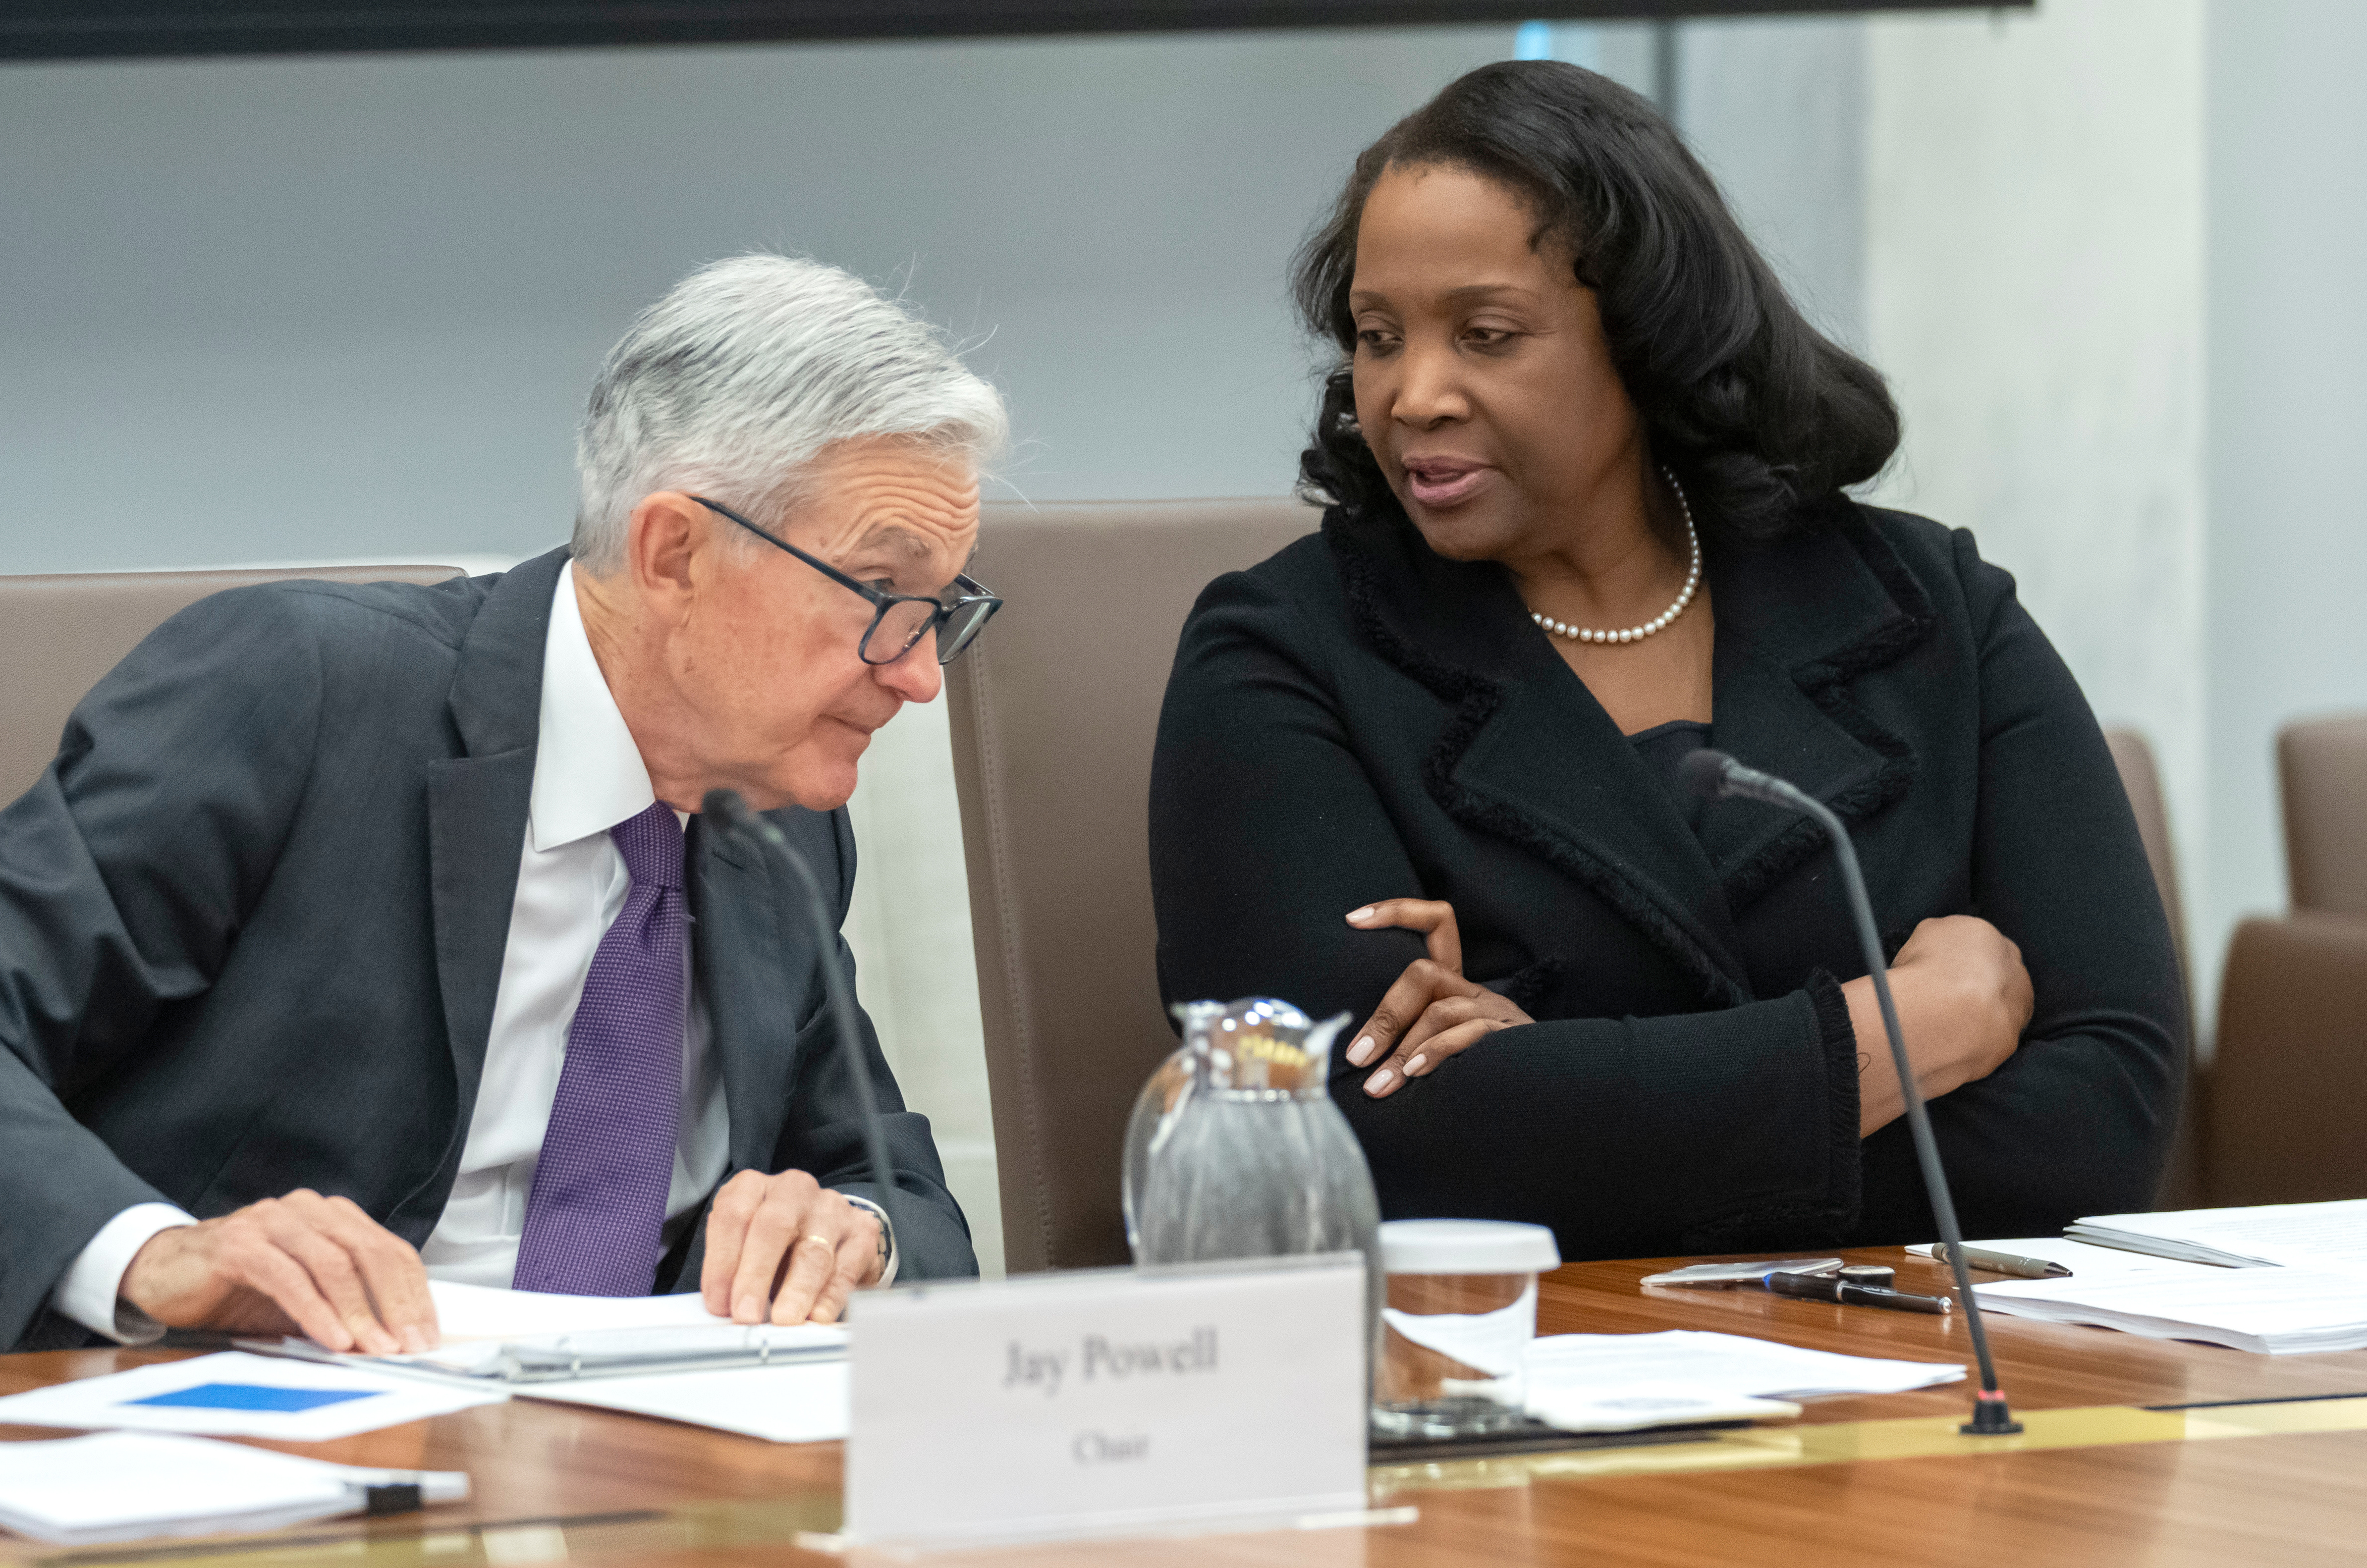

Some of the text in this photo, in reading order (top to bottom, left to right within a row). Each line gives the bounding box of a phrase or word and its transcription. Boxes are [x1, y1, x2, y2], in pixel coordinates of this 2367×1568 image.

[1003, 1327, 1218, 1395] Jay Powell
[1072, 1431, 1150, 1464] Chair
